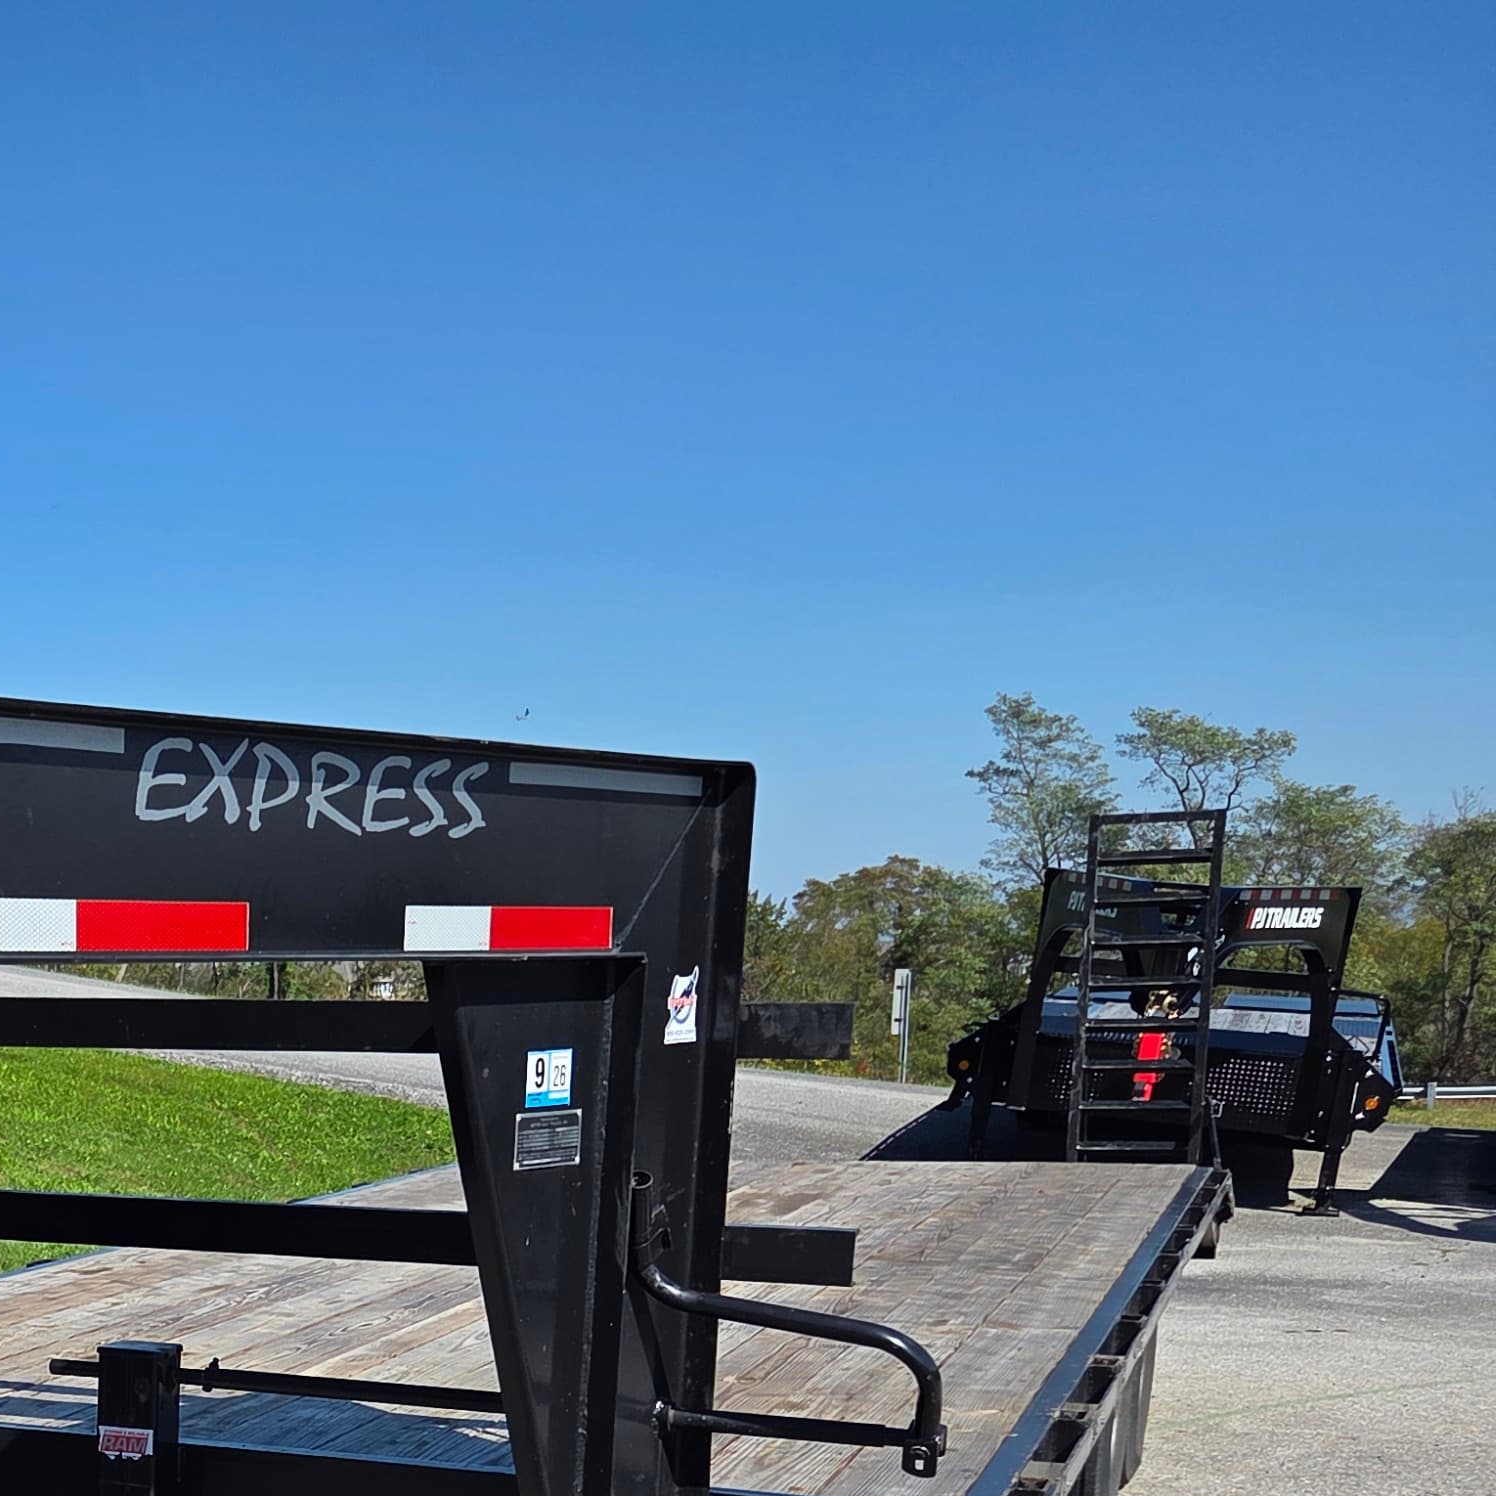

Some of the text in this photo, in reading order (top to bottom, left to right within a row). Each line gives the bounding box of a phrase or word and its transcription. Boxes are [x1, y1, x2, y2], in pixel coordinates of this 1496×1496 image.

[134, 736, 490, 839] EXPRESS
[534, 1057, 567, 1089] 9 26
[102, 1435, 147, 1454] RAM
